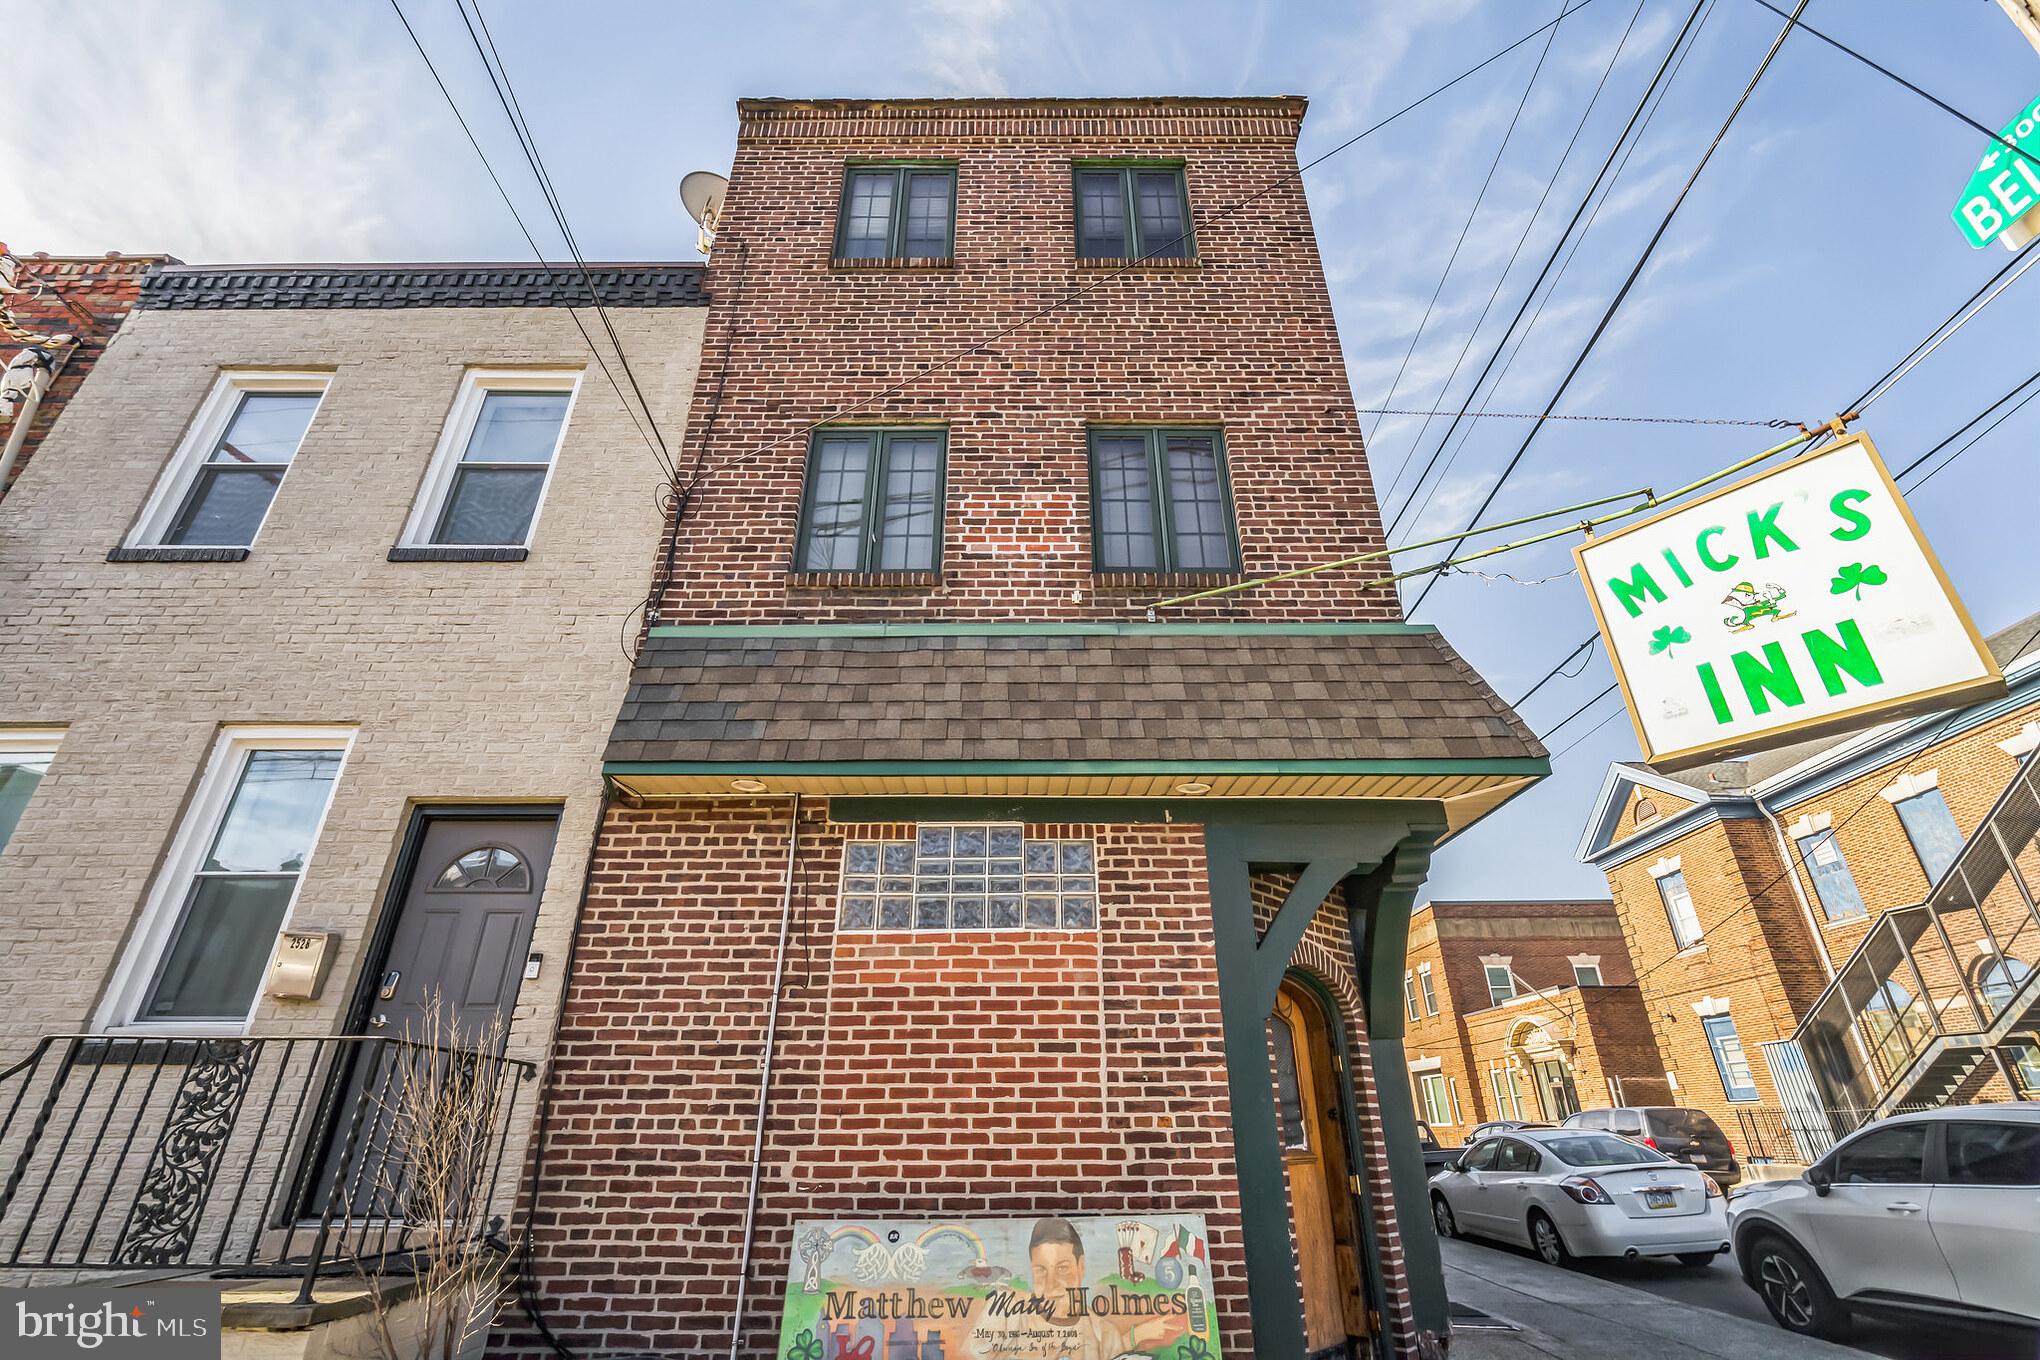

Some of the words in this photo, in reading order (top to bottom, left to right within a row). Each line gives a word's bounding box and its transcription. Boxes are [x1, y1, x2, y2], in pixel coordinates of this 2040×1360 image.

[1696, 618, 1884, 725] INN
[1164, 1266, 1176, 1282] 5
[822, 1287, 975, 1320] Matthew
[985, 1289, 1057, 1321] Matty
[1066, 1285, 1188, 1317] Holmes
[974, 1328, 995, 1342] May
[1026, 1328, 1055, 1342] August
